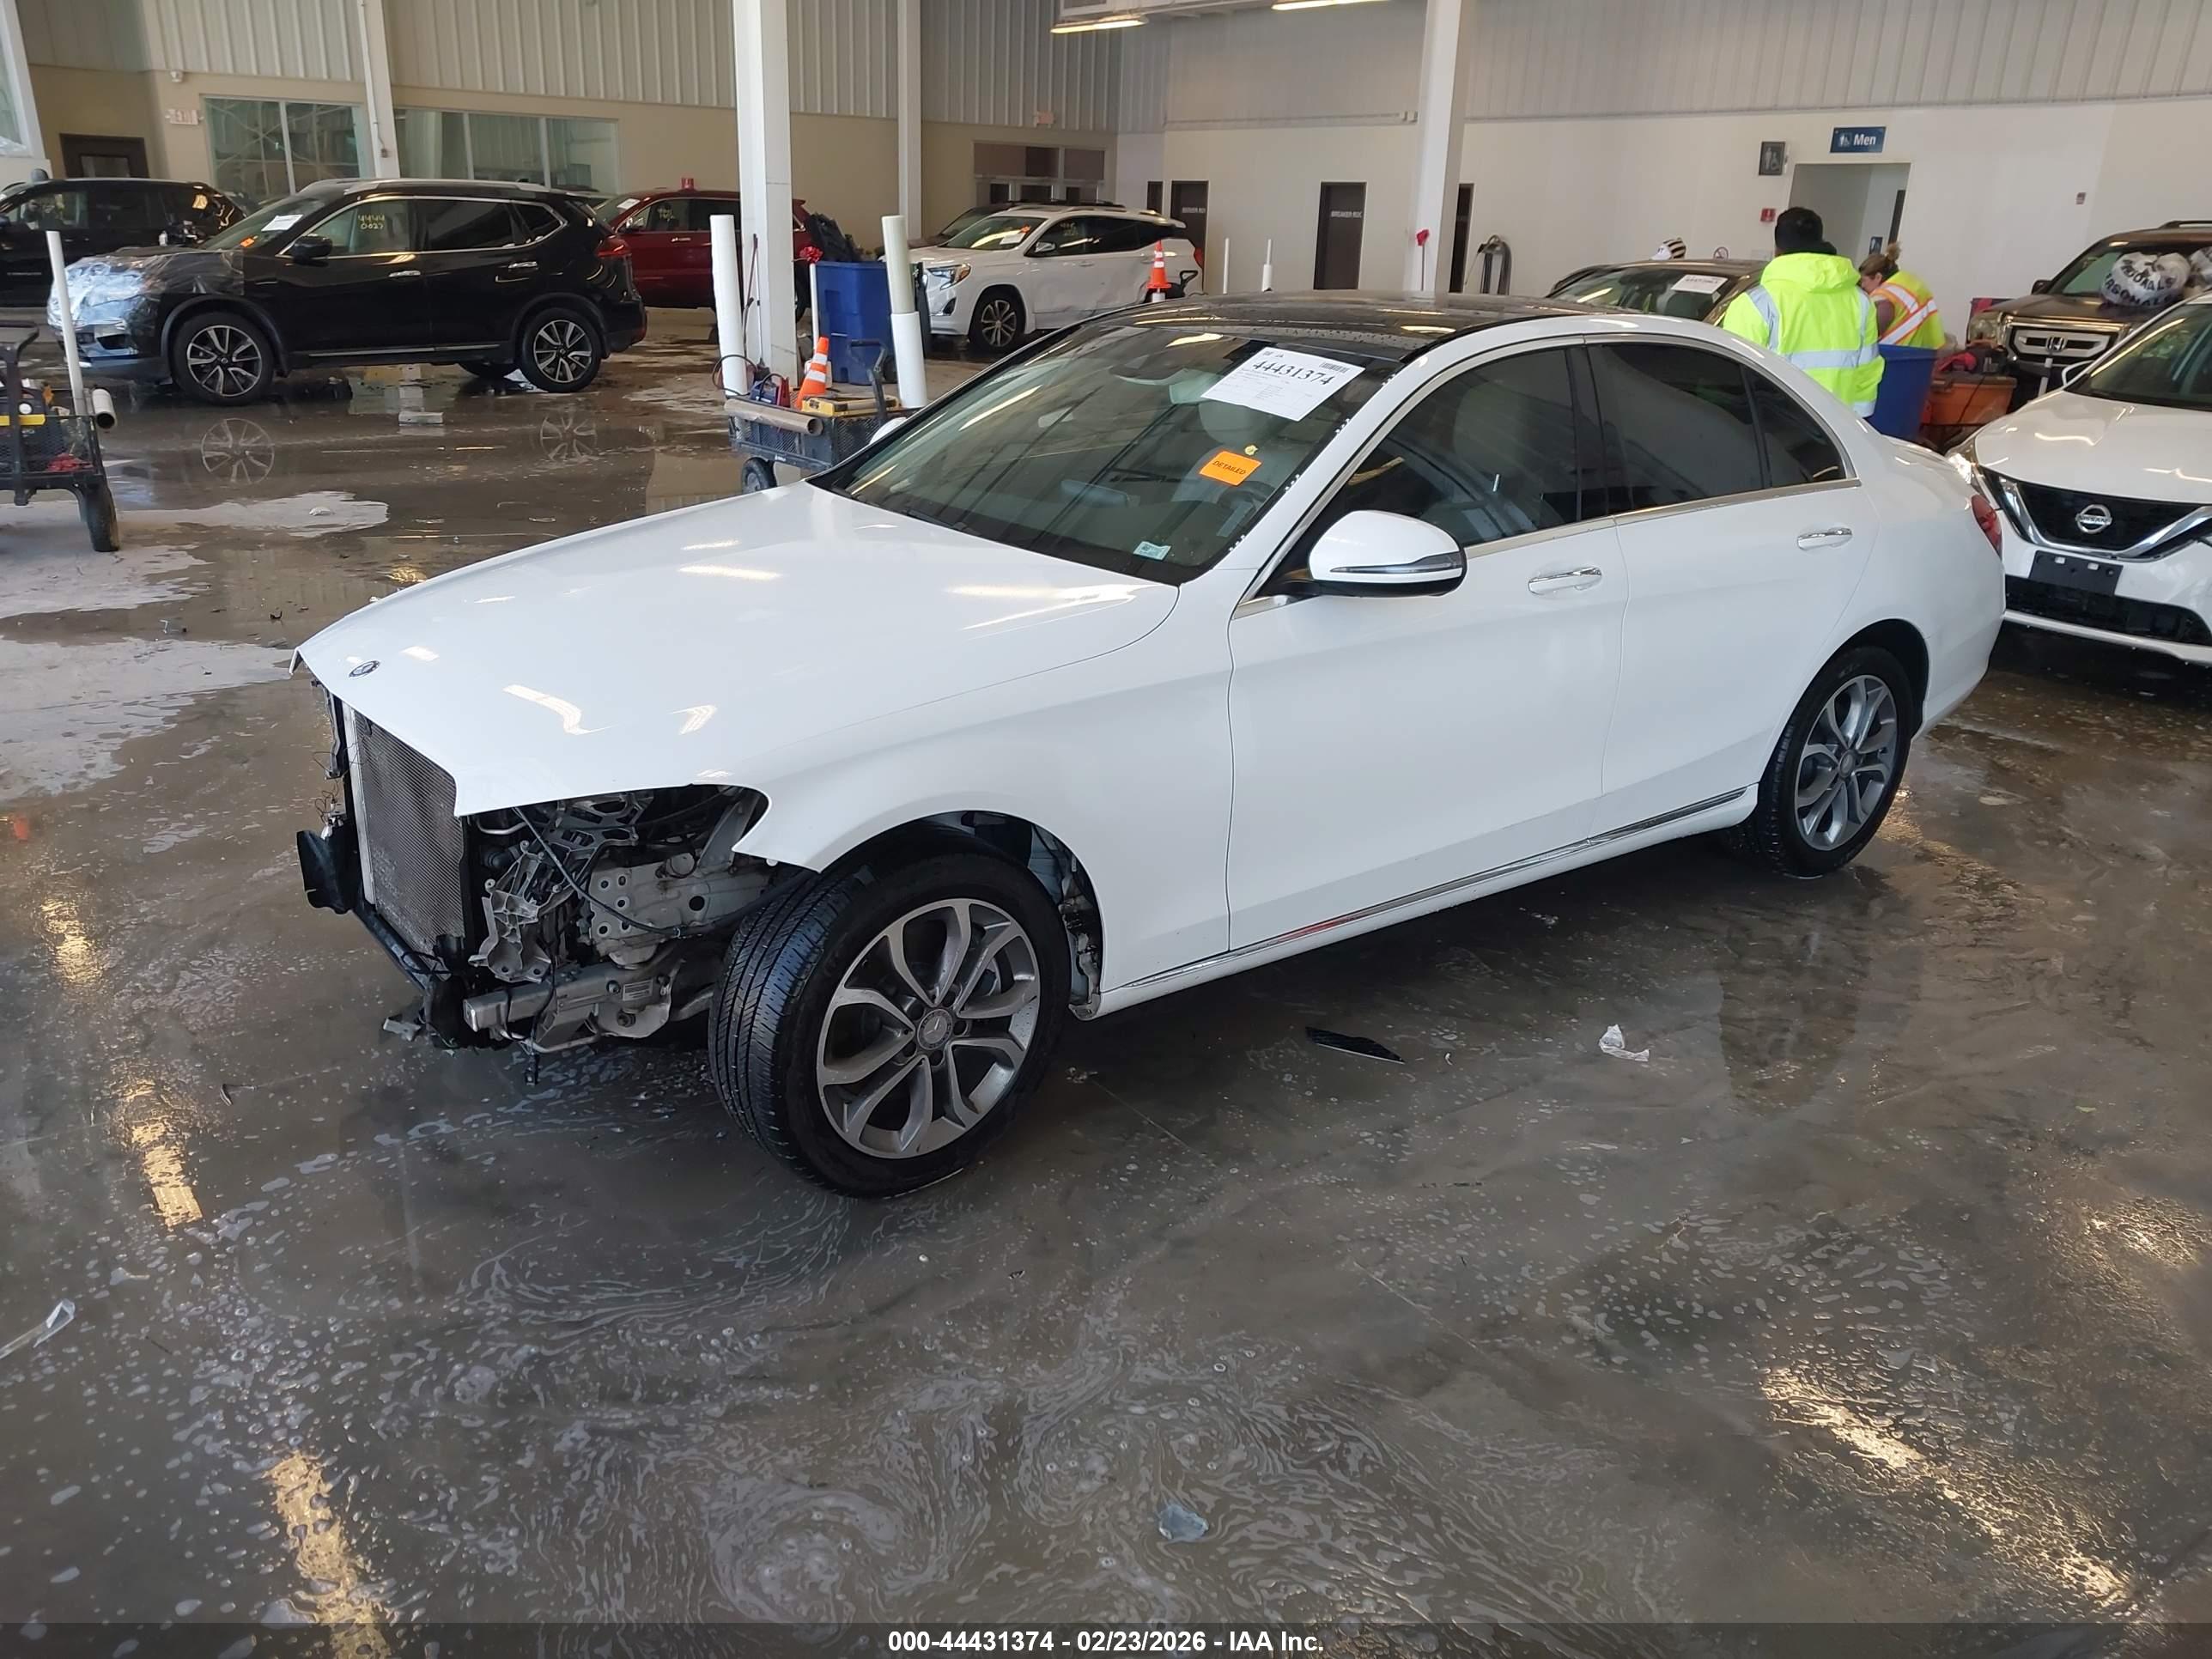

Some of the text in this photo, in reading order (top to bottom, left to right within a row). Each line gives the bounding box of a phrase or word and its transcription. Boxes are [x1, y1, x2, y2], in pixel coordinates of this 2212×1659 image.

[1853, 133, 1877, 146] Men
[1252, 360, 1335, 386] 44431374
[1212, 460, 1246, 475] DETAILED
